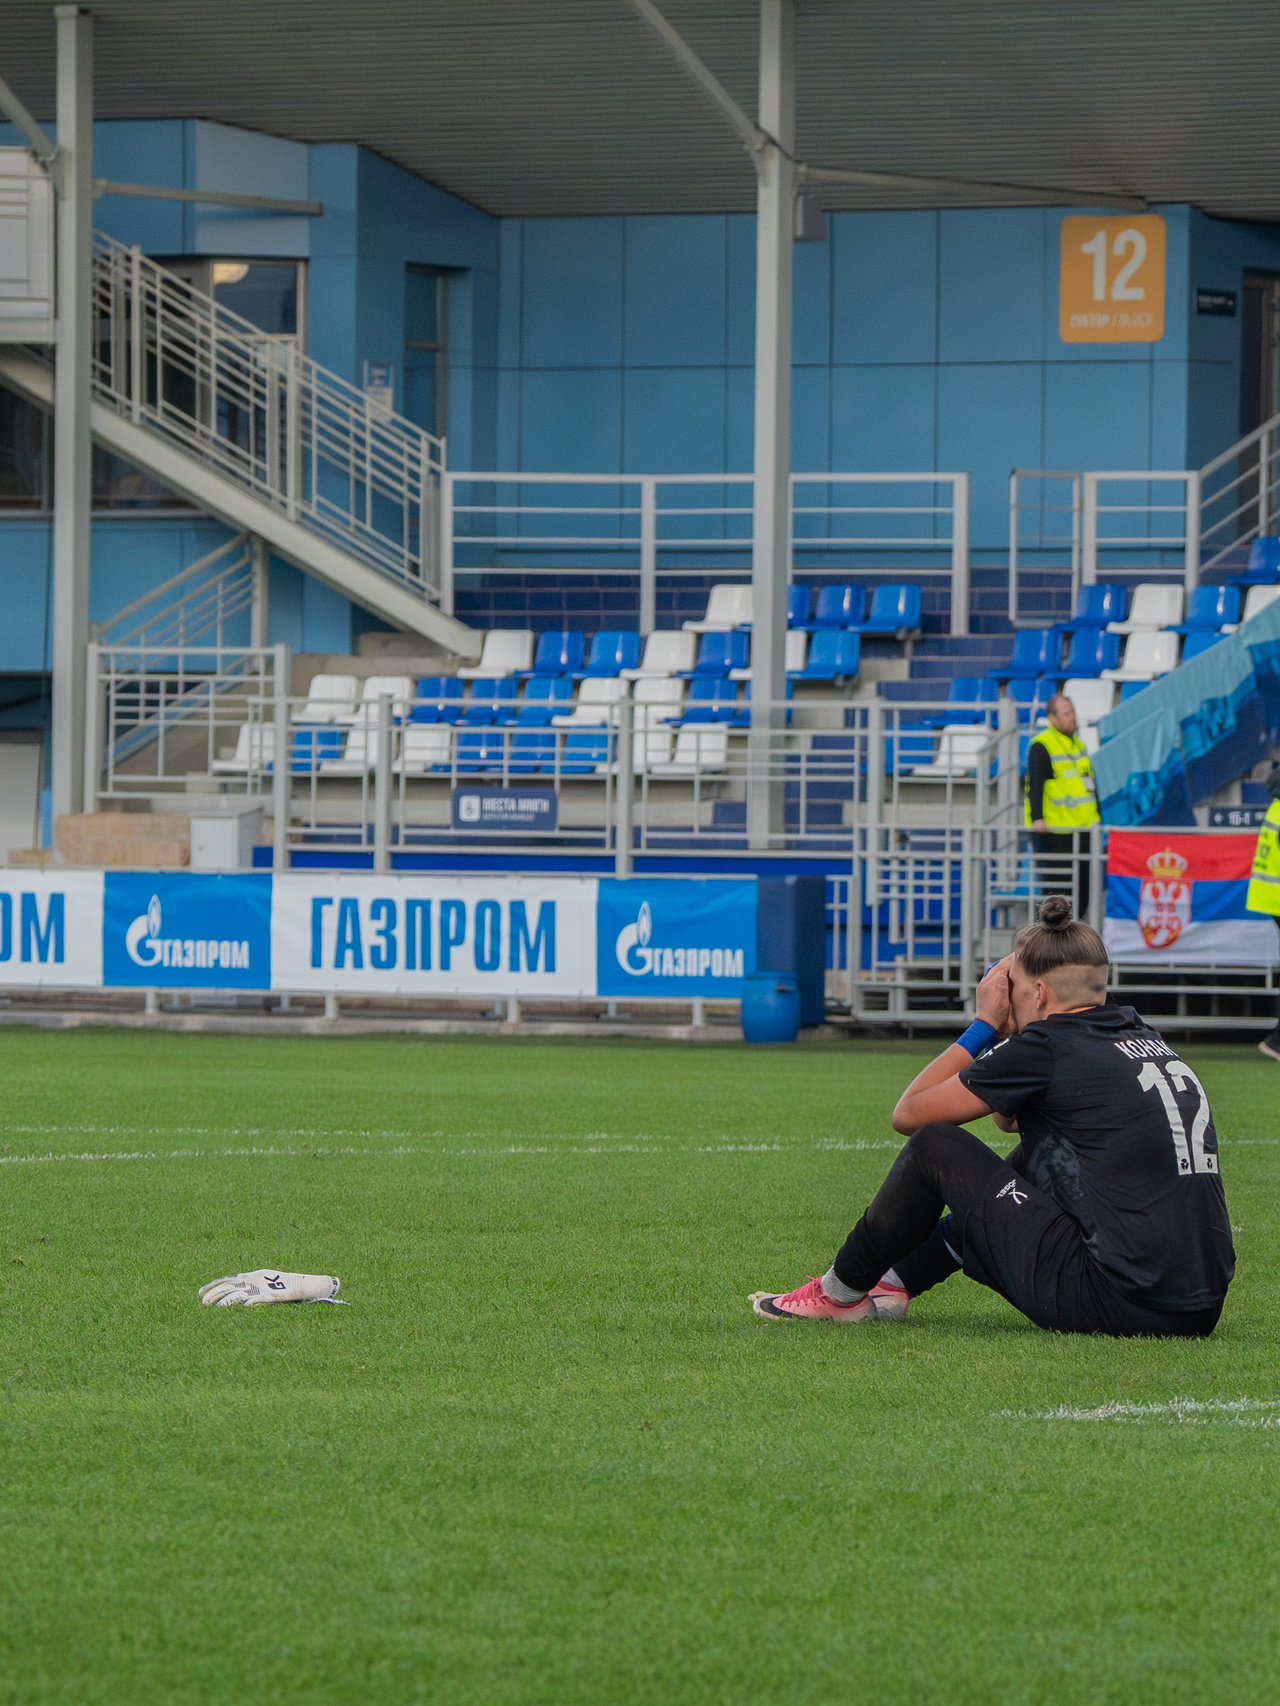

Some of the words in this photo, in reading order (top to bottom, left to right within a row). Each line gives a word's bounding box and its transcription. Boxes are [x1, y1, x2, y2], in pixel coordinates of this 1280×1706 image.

[1081, 229, 1147, 301] 12
[162, 939, 250, 969] ГАЗПРОМ
[311, 896, 556, 973] ГАЗПРОМ
[653, 947, 744, 977] ГАЗПРОМ
[1136, 1060, 1219, 1176] 12
